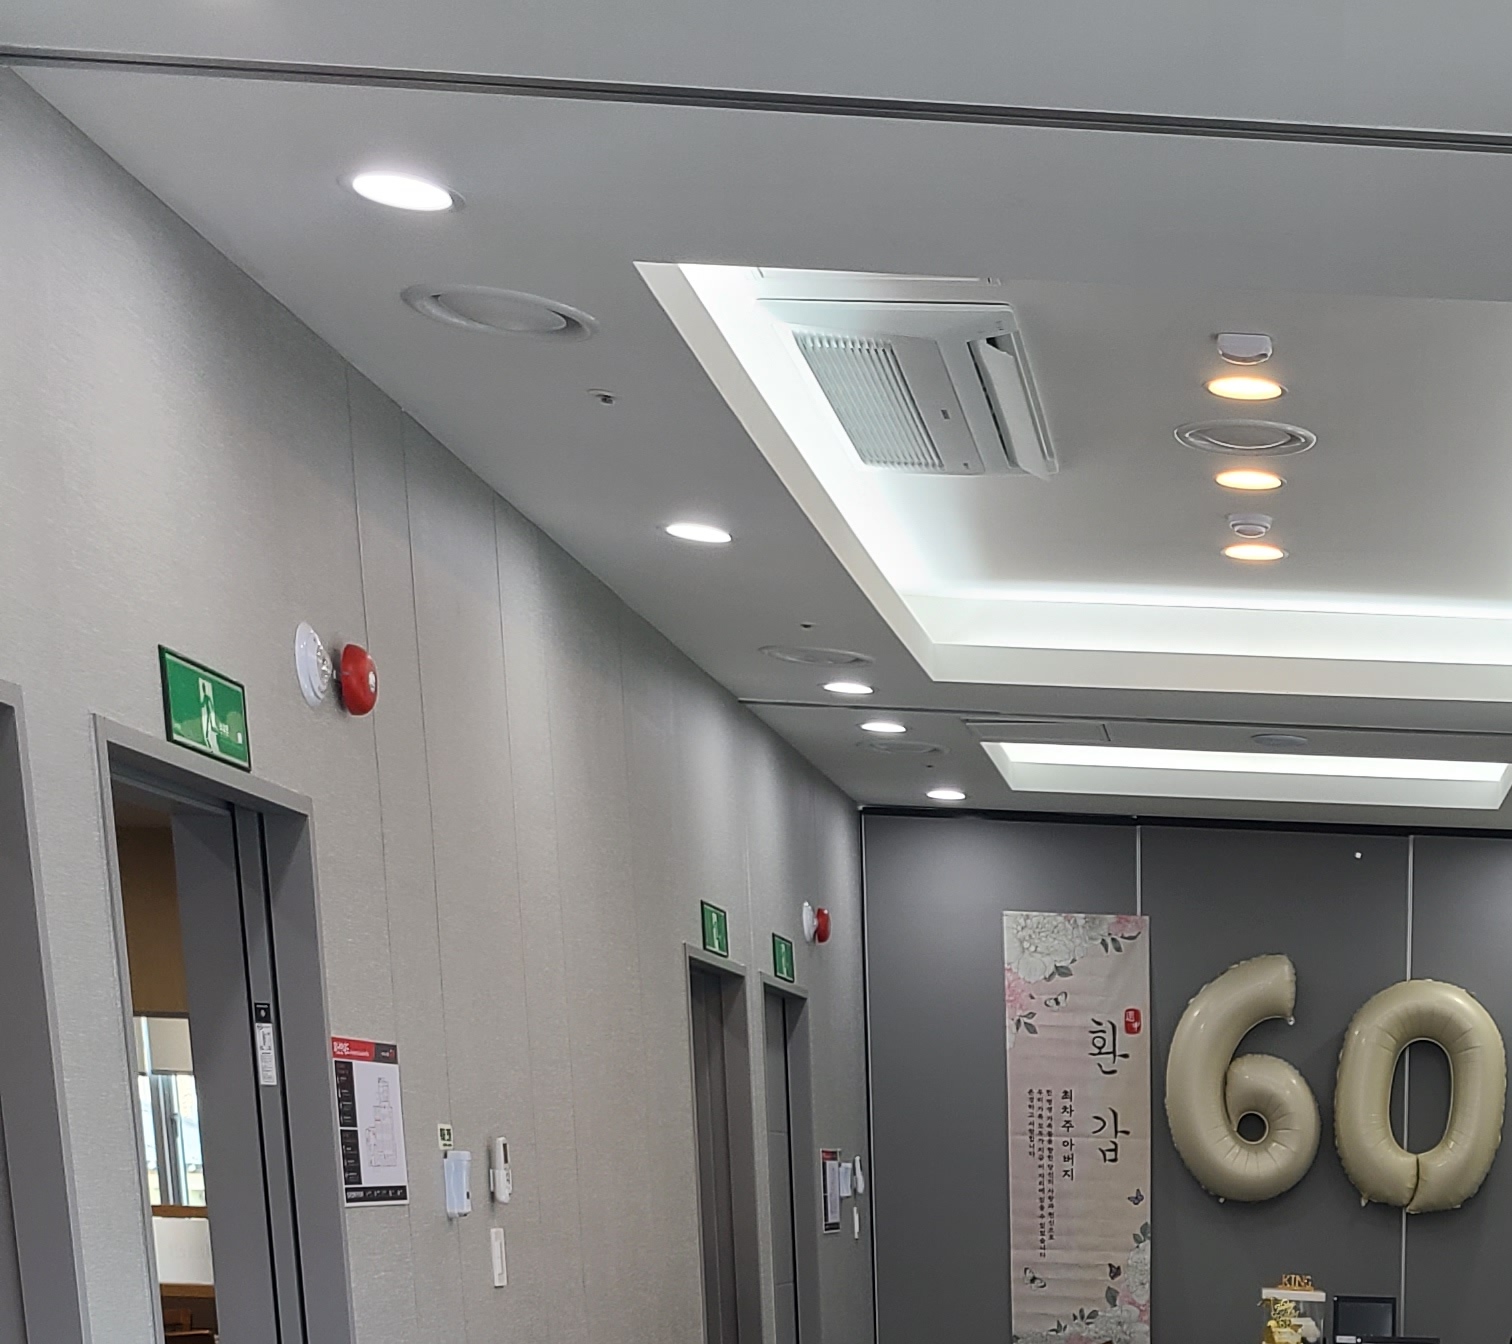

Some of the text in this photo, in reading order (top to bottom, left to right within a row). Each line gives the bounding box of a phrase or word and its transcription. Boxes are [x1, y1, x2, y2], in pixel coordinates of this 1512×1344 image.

[1061, 1089, 1076, 1181] 최차주 아버지
[1165, 953, 1508, 1214] 60
